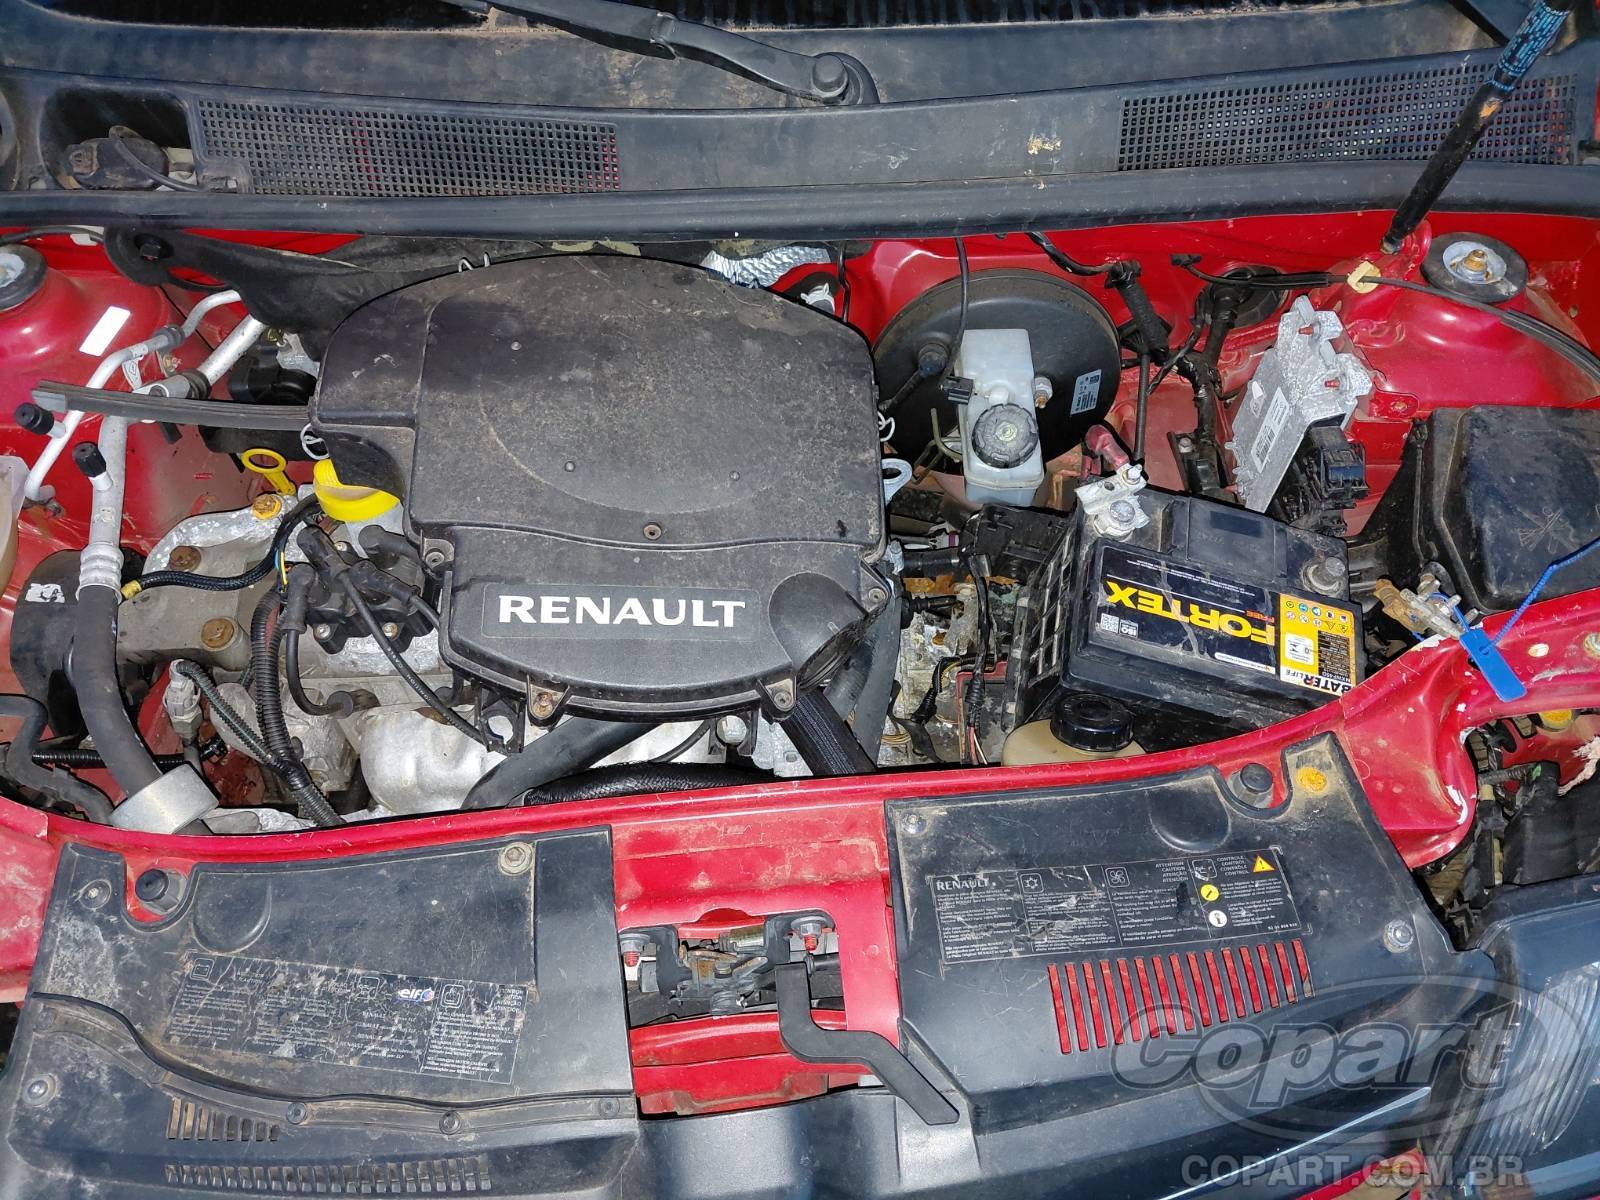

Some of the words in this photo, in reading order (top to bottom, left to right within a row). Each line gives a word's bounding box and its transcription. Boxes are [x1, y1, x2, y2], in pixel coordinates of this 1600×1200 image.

[499, 595, 746, 627] RENAULT
[1106, 580, 1275, 646] FORTEX
[936, 879, 990, 891] RENAULT
[400, 988, 422, 998] elf
